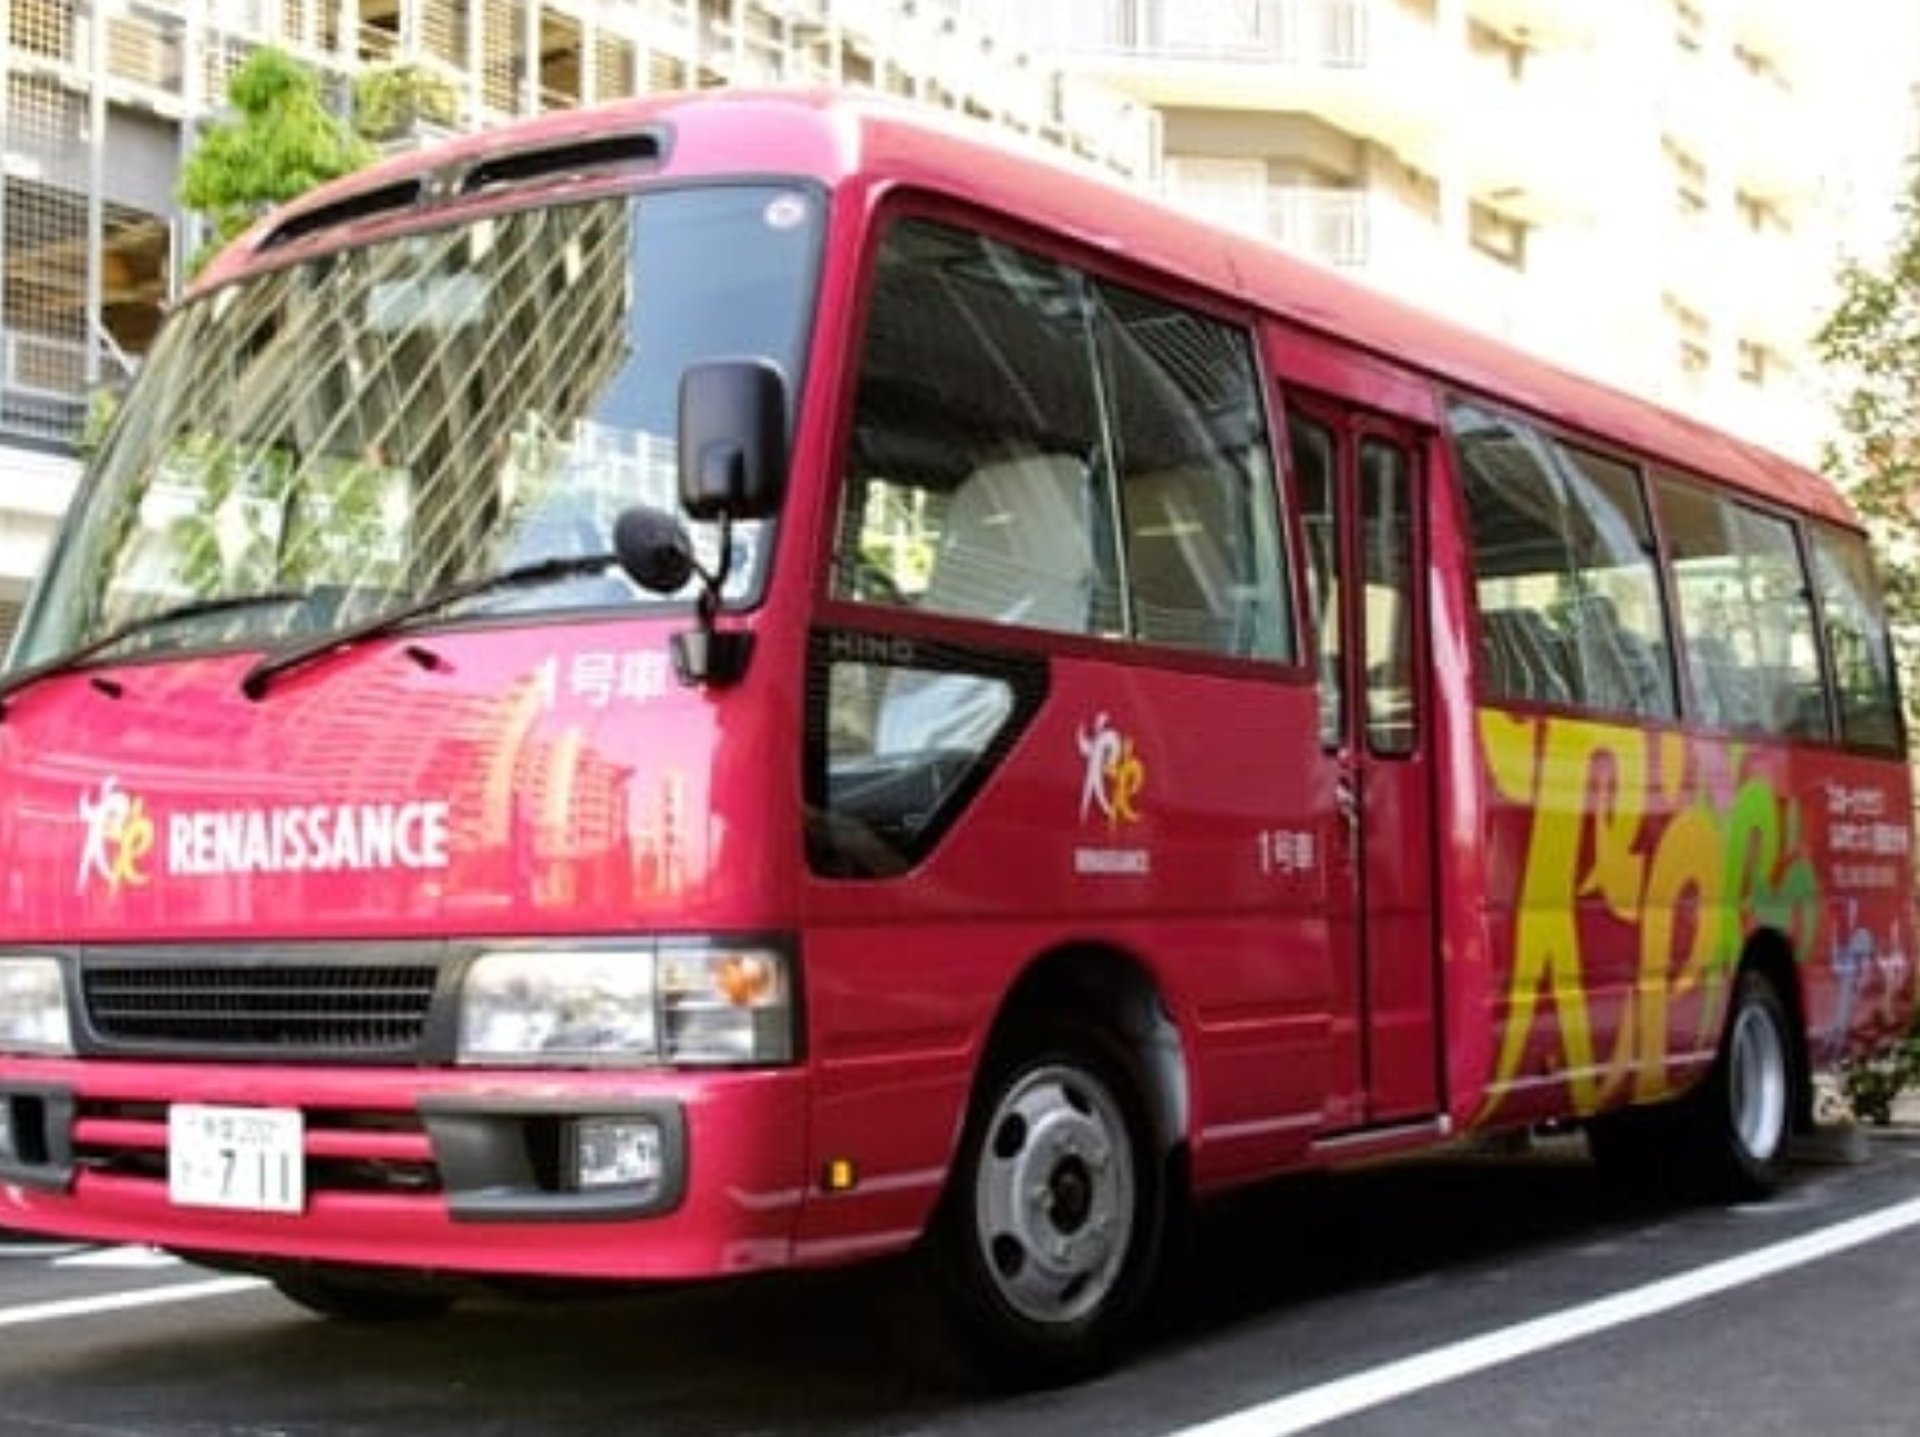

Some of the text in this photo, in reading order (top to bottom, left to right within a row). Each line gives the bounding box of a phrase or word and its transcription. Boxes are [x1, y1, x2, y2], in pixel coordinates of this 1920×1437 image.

[828, 633, 915, 661] HINO
[166, 800, 449, 875] RENAISSANCE
[219, 1149, 291, 1203] 711
